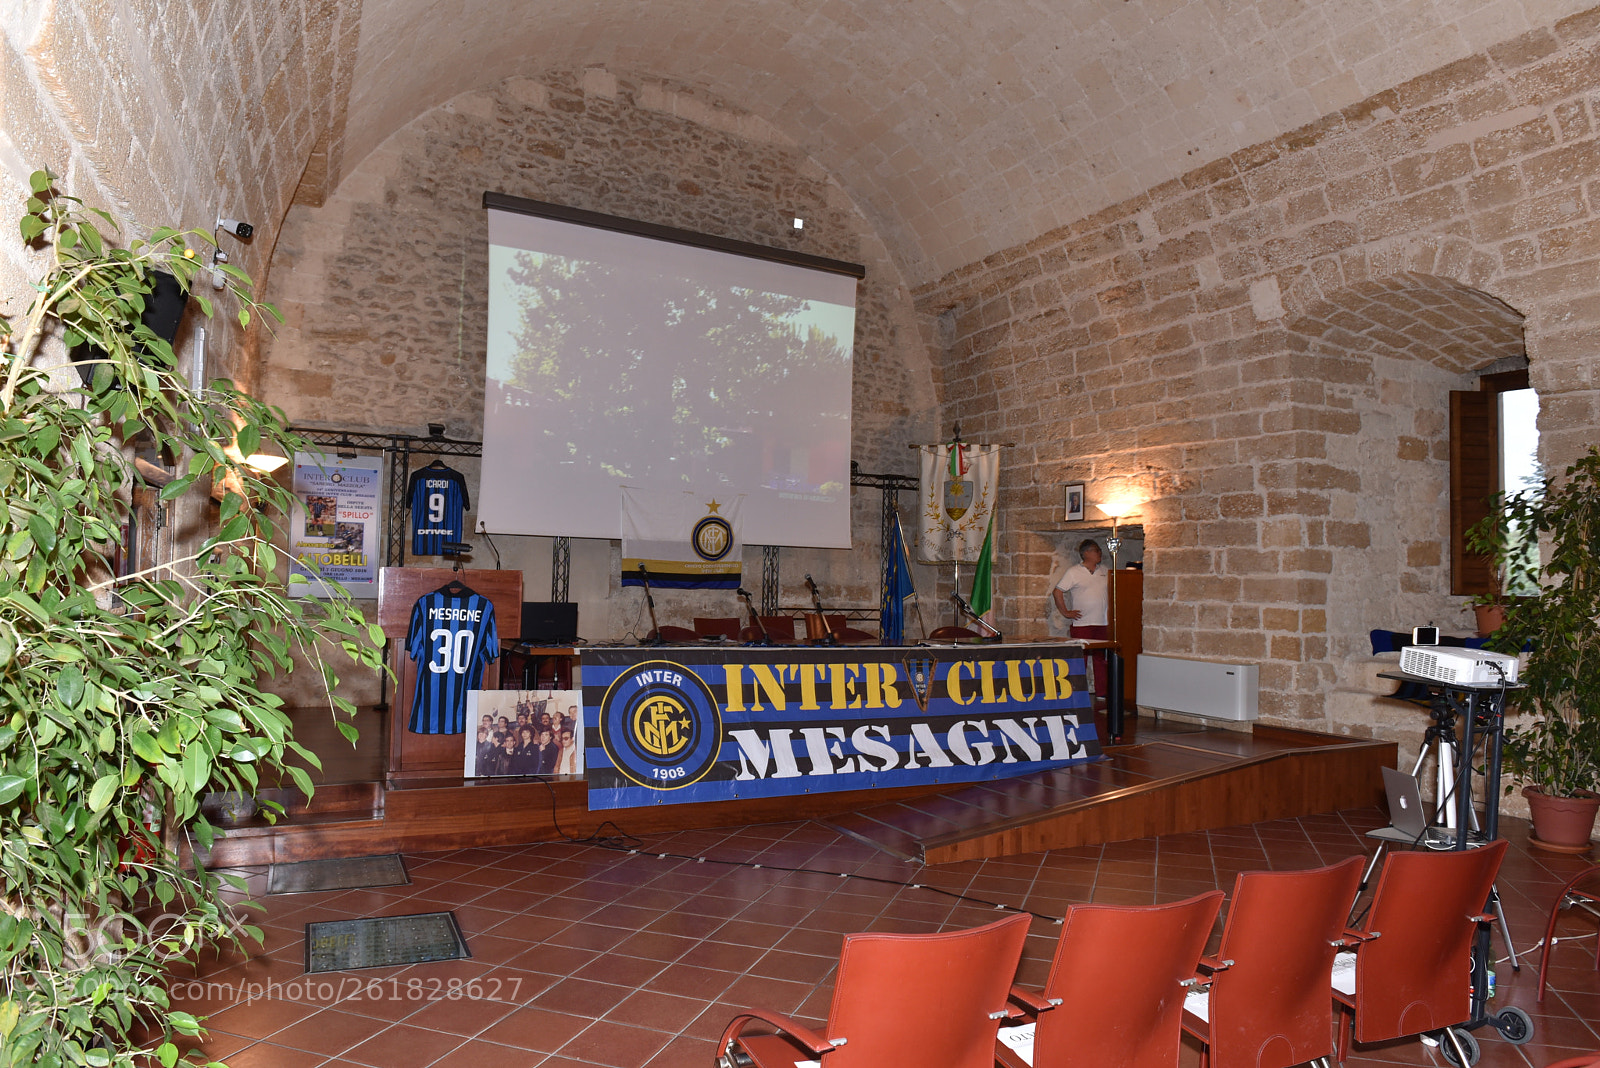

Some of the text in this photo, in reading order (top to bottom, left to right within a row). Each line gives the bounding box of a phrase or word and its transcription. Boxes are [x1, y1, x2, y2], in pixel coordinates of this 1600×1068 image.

[342, 475, 370, 484] CLUB
[425, 480, 449, 489] ICARDI
[338, 511, 374, 519] "SPILLO"
[428, 493, 445, 523] 9
[429, 607, 482, 622] MESAGNE
[428, 628, 475, 674] 30
[635, 670, 683, 687] INTER
[722, 658, 1074, 712] INTER CLUB
[728, 714, 1088, 782] MESAGNE
[652, 766, 686, 780] 1908
